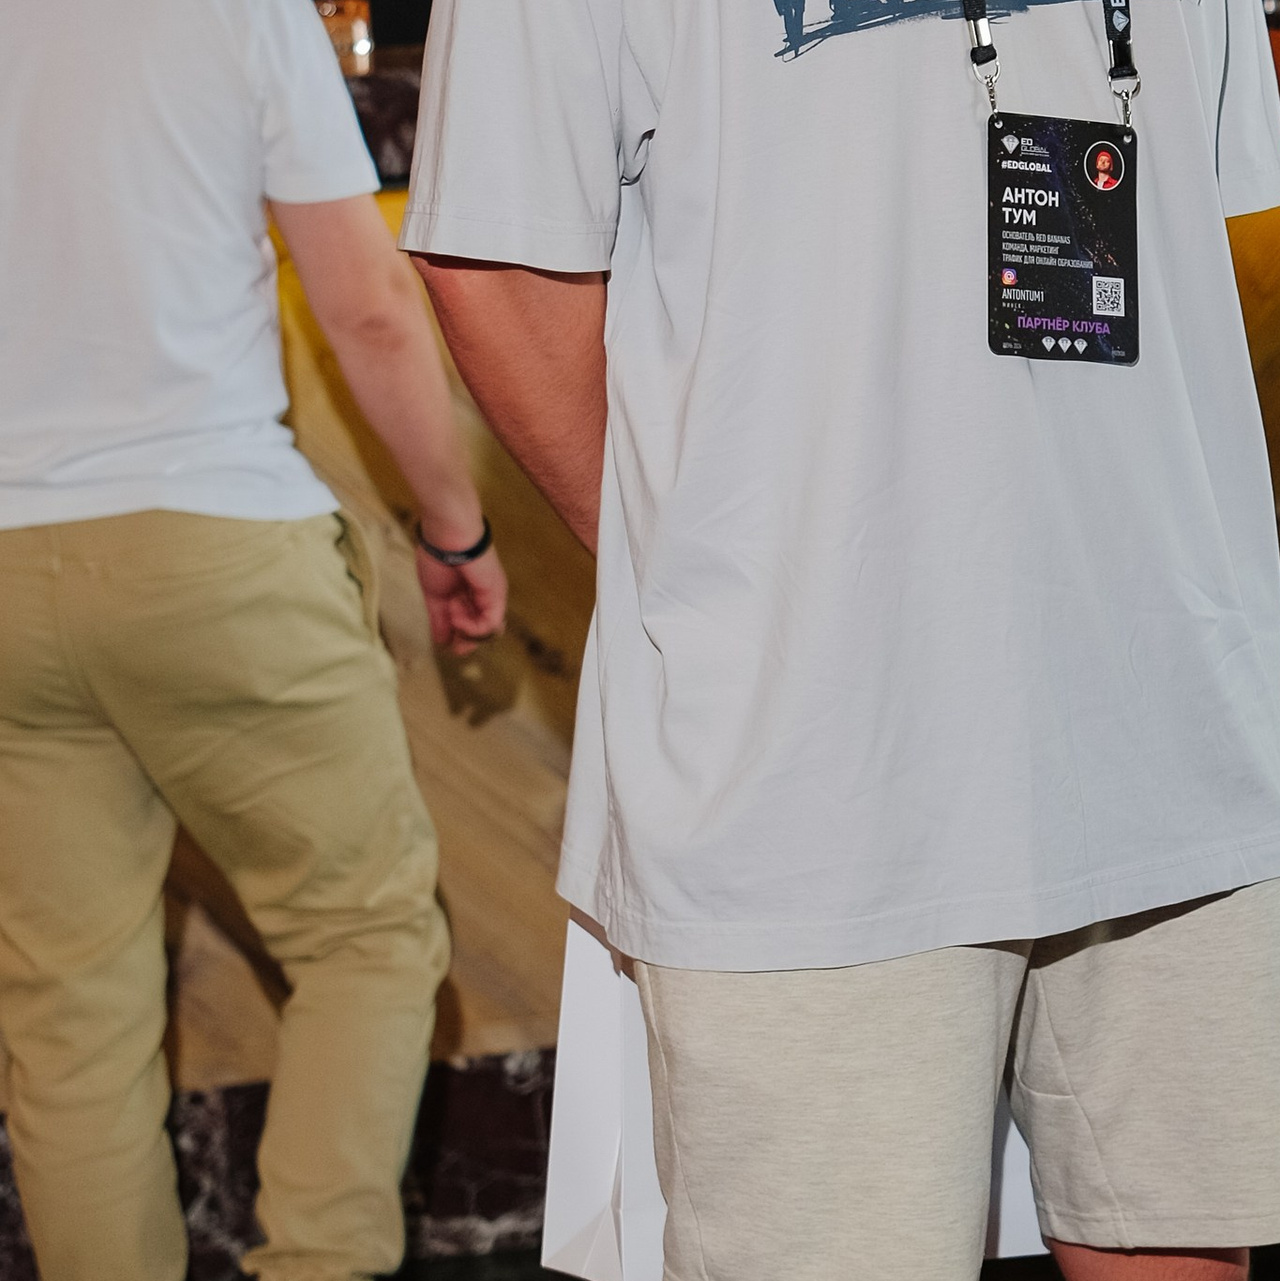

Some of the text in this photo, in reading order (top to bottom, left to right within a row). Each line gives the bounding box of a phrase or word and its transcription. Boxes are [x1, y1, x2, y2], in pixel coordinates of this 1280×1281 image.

[1001, 160, 1053, 173] #EDGLOBAL
[1002, 186, 1060, 208] АНТОН
[1002, 207, 1037, 226] ТУМ
[1002, 288, 1044, 303] ANTONTUM1
[1017, 315, 1111, 335] ПАРТНЁР КЛУБА
